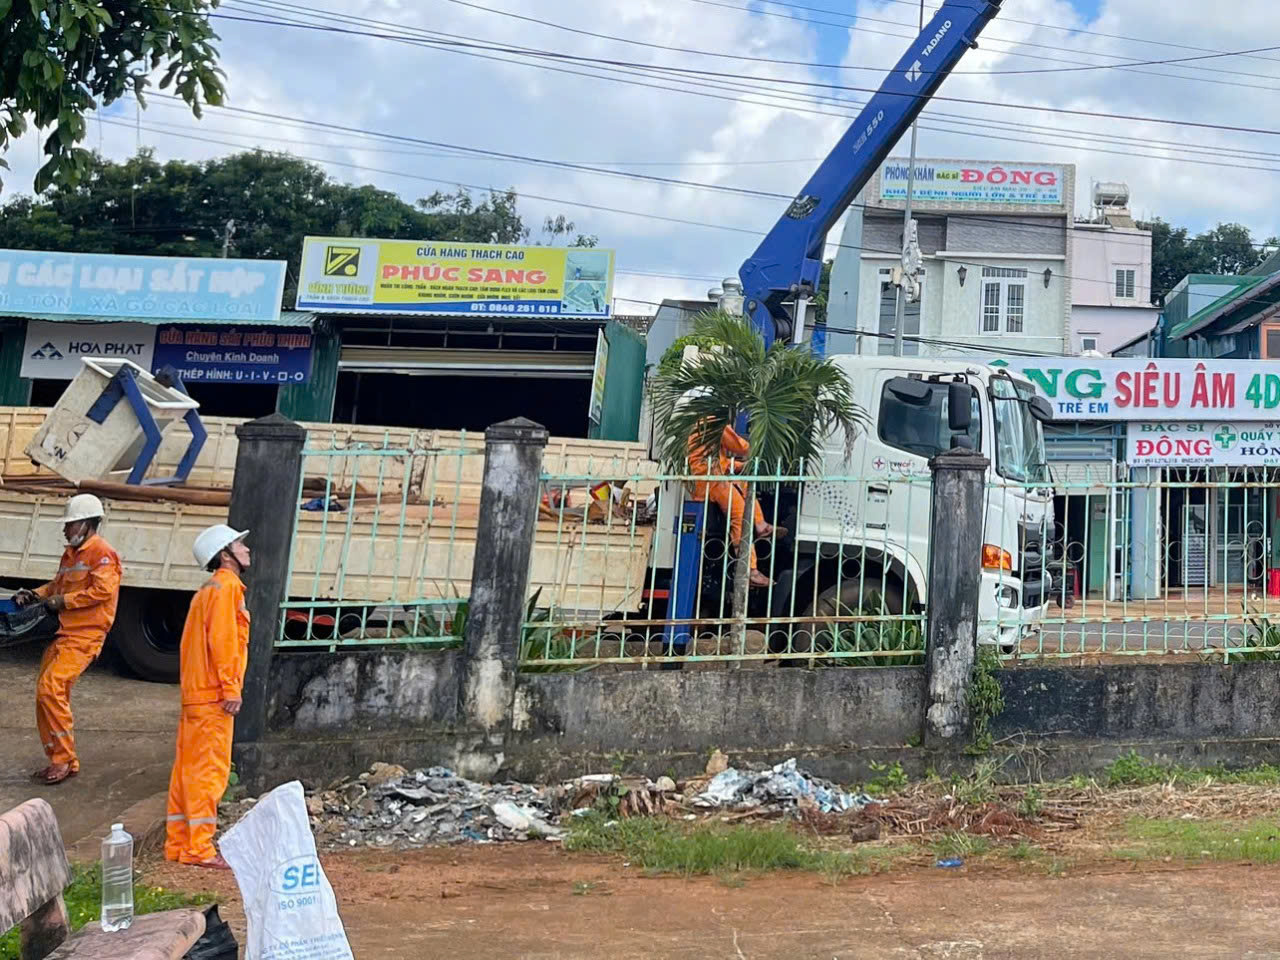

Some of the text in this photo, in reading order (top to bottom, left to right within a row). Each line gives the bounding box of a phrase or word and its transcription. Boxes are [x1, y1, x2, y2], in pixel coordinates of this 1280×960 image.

[922, 20, 952, 57] TADANO
[866, 110, 884, 136] 550
[885, 163, 910, 180] PHÒNG
[912, 164, 935, 181] KHÁM
[960, 166, 1058, 185] ĐÔNG
[416, 246, 525, 260] CỬA HÀNG THẠCH CAO
[382, 263, 547, 285] PHÚC SANG
[186, 351, 280, 362] Chuyên Kinh Doanh
[178, 367, 203, 378] THÉP
[1114, 362, 1180, 408] SIÊU
[1190, 362, 1235, 408] ÂM
[1058, 399, 1108, 413] TRẺ EM
[1136, 435, 1213, 456] ĐÔNG
[278, 896, 316, 911] ISO 9001
